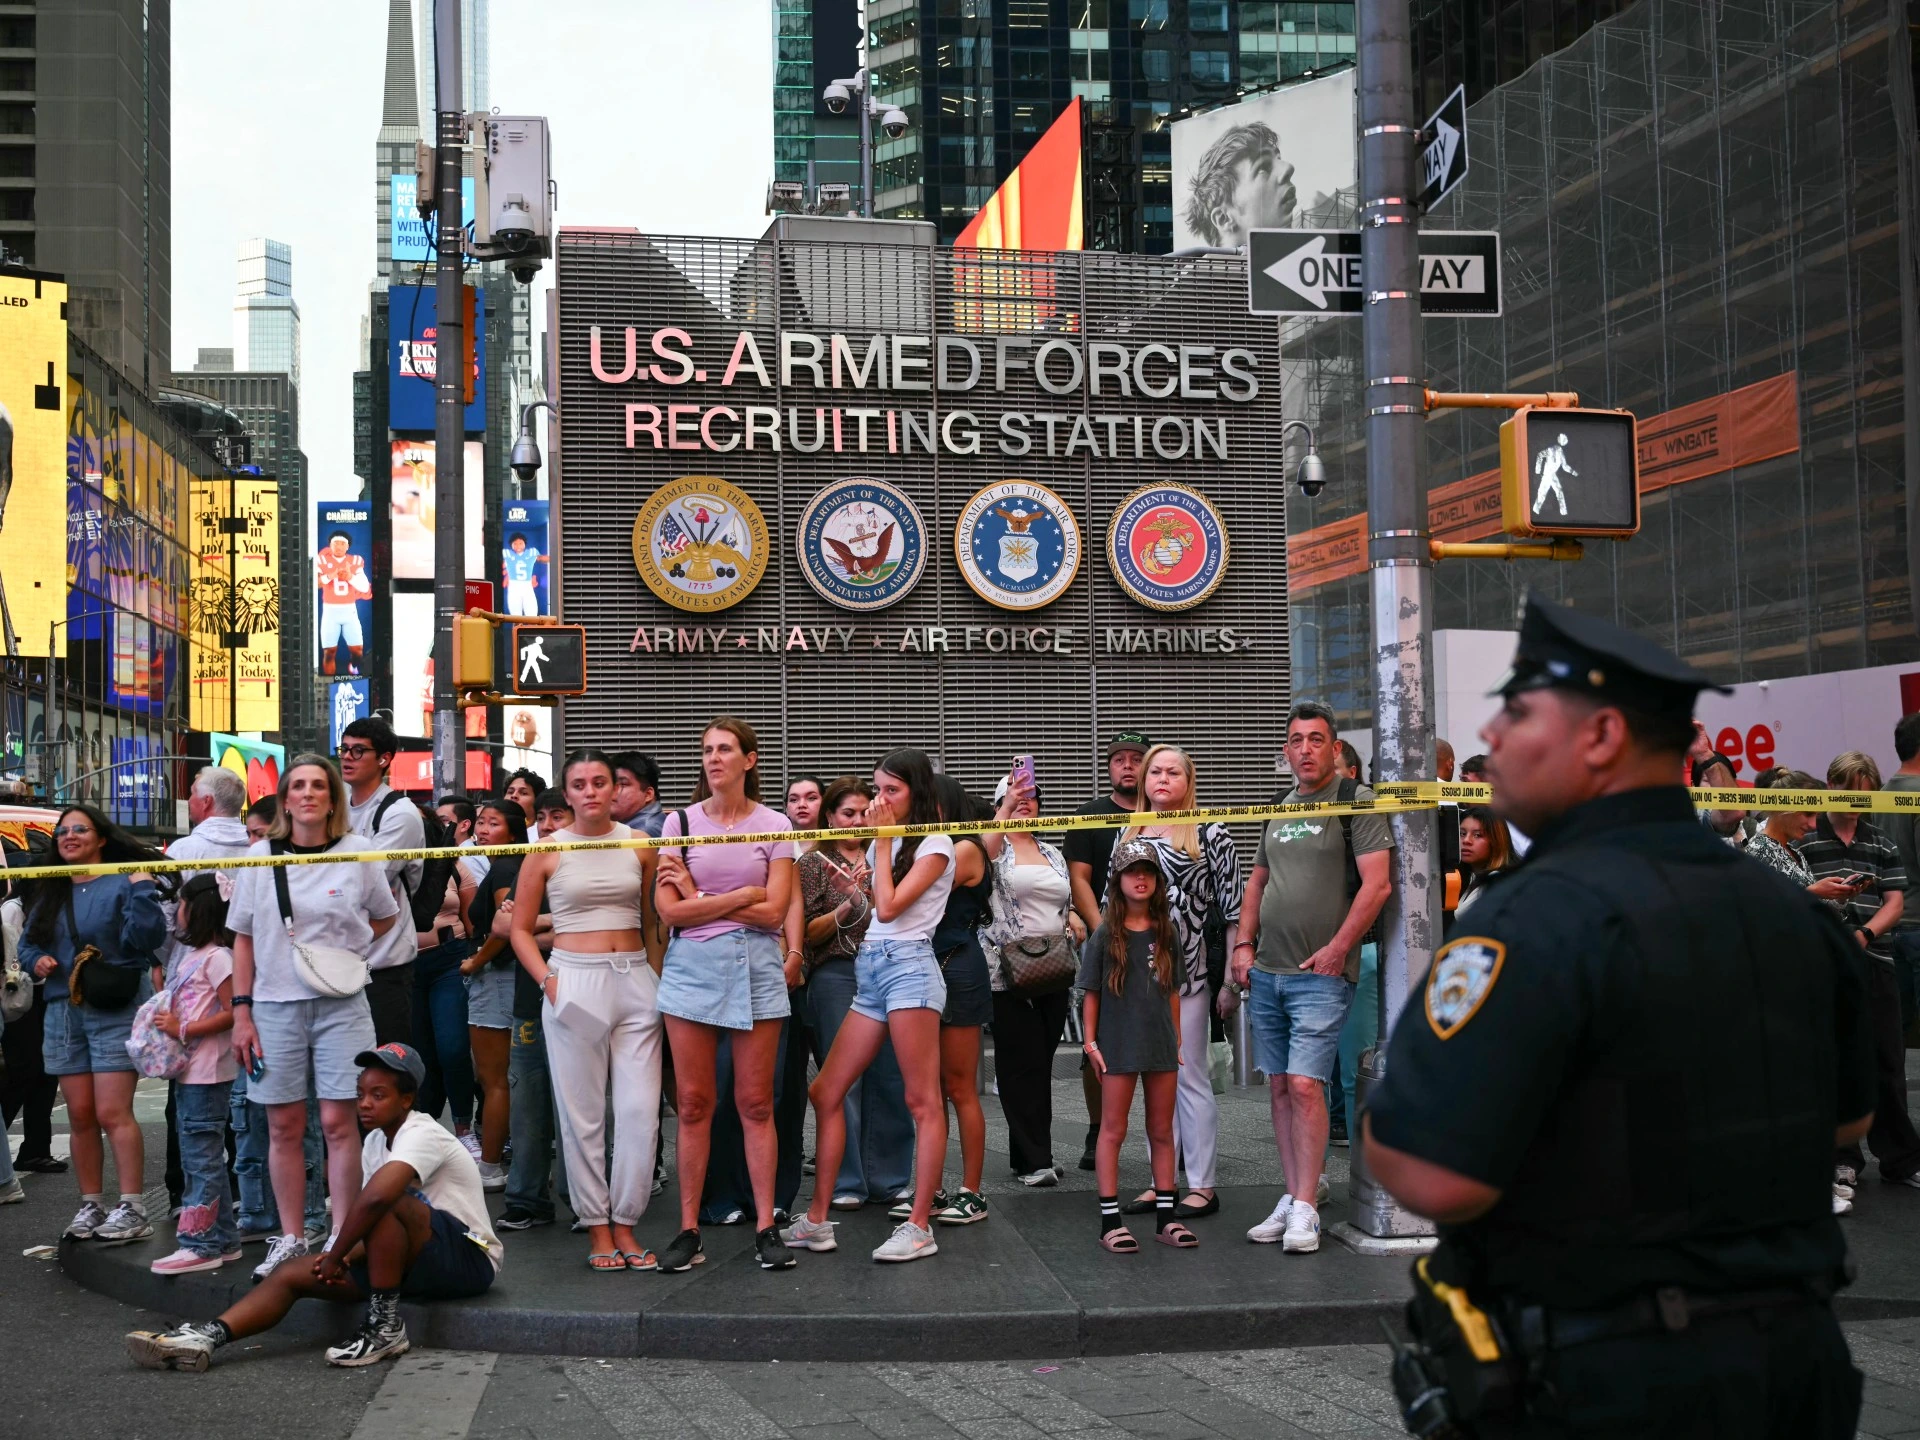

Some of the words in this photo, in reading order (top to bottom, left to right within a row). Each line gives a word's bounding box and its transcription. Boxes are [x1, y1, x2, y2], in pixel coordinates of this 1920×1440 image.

[1422, 133, 1448, 184] WAY
[1299, 256, 1362, 287] ONE
[1419, 259, 1471, 289] AY
[590, 326, 707, 385] U.S.
[721, 331, 981, 391] ARMED
[995, 336, 1259, 402] FORCES
[625, 403, 981, 455] RECRUITING
[999, 411, 1229, 460] STATION
[1664, 426, 1718, 456] WINGATE
[251, 490, 262, 505] It
[326, 511, 368, 521] CHAMBLISS
[508, 510, 527, 520] LACY
[640, 481, 701, 533] DEPARTMENT
[707, 483, 722, 493] OF
[726, 489, 746, 508] THE
[746, 511, 764, 544] ARMY
[809, 490, 856, 541] DEPARTMENT
[860, 490, 874, 499] OF
[879, 493, 898, 510] THE
[896, 508, 915, 533] NAVY
[1118, 493, 1166, 547] DEPARTMENT
[1168, 494, 1180, 502] OF
[1181, 497, 1198, 511] THE
[1197, 509, 1218, 539] NAVY
[250, 523, 263, 537] in
[960, 490, 995, 562] DEPARTMENT
[1001, 485, 1017, 495] OF
[1025, 486, 1050, 503] THE
[1051, 505, 1069, 524] AIR
[1063, 530, 1077, 571] FORCE
[243, 539, 268, 554] You
[640, 544, 663, 587] UNITED
[663, 587, 709, 607] STATES
[713, 594, 727, 606] OF
[729, 552, 763, 599] AMERICA
[809, 552, 836, 588] UNITED
[834, 584, 871, 599] STATES
[873, 586, 887, 597] OF
[889, 548, 917, 590] AMERICA
[1121, 556, 1144, 587] UNITED
[1144, 585, 1174, 598] STATES
[1177, 576, 1207, 597] MARINE
[1204, 549, 1218, 576] CORPS
[465, 585, 480, 595] PING
[688, 582, 713, 590] 1775
[971, 571, 991, 593] UNITED
[995, 590, 1018, 603] STATES
[1038, 578, 1064, 600] AMERICA
[999, 581, 1037, 592] MCMXLVII
[629, 626, 728, 653] ARMY
[757, 626, 856, 653] NAVY
[899, 627, 949, 652] AIR
[965, 627, 1073, 654] FORCE
[1106, 627, 1237, 653] MARINES
[241, 651, 262, 663] See
[264, 651, 273, 663] it
[239, 665, 276, 679] Today.
[1706, 723, 1776, 774] ee
[1441, 787, 1461, 797] CROSS
[1462, 787, 1475, 797] NOT
[1475, 787, 1484, 797] DO
[1692, 792, 1703, 802] NOT
[1704, 792, 1712, 802] DO
[1718, 793, 1737, 803] SCENE
[1738, 793, 1757, 804] CRIME
[1759, 793, 1777, 805] (8477)
[1778, 794, 1823, 806] 1-800-577-TIPS
[1895, 796, 1914, 807] CROSS
[1157, 811, 1178, 819] CROSS
[1178, 810, 1191, 818] NOT
[1192, 809, 1201, 817] DO
[1207, 808, 1228, 816] SCENE
[1229, 807, 1249, 815] CRIME
[905, 825, 926, 834] CROSS
[928, 824, 940, 833] NOT
[941, 823, 951, 832] DO
[958, 822, 979, 831] SCENE
[981, 821, 1001, 830] CRIME
[649, 839, 670, 847] CROSS
[671, 838, 684, 846] NOT
[685, 837, 695, 845] DO
[702, 836, 724, 844] SCENE
[725, 835, 747, 843] CRIME
